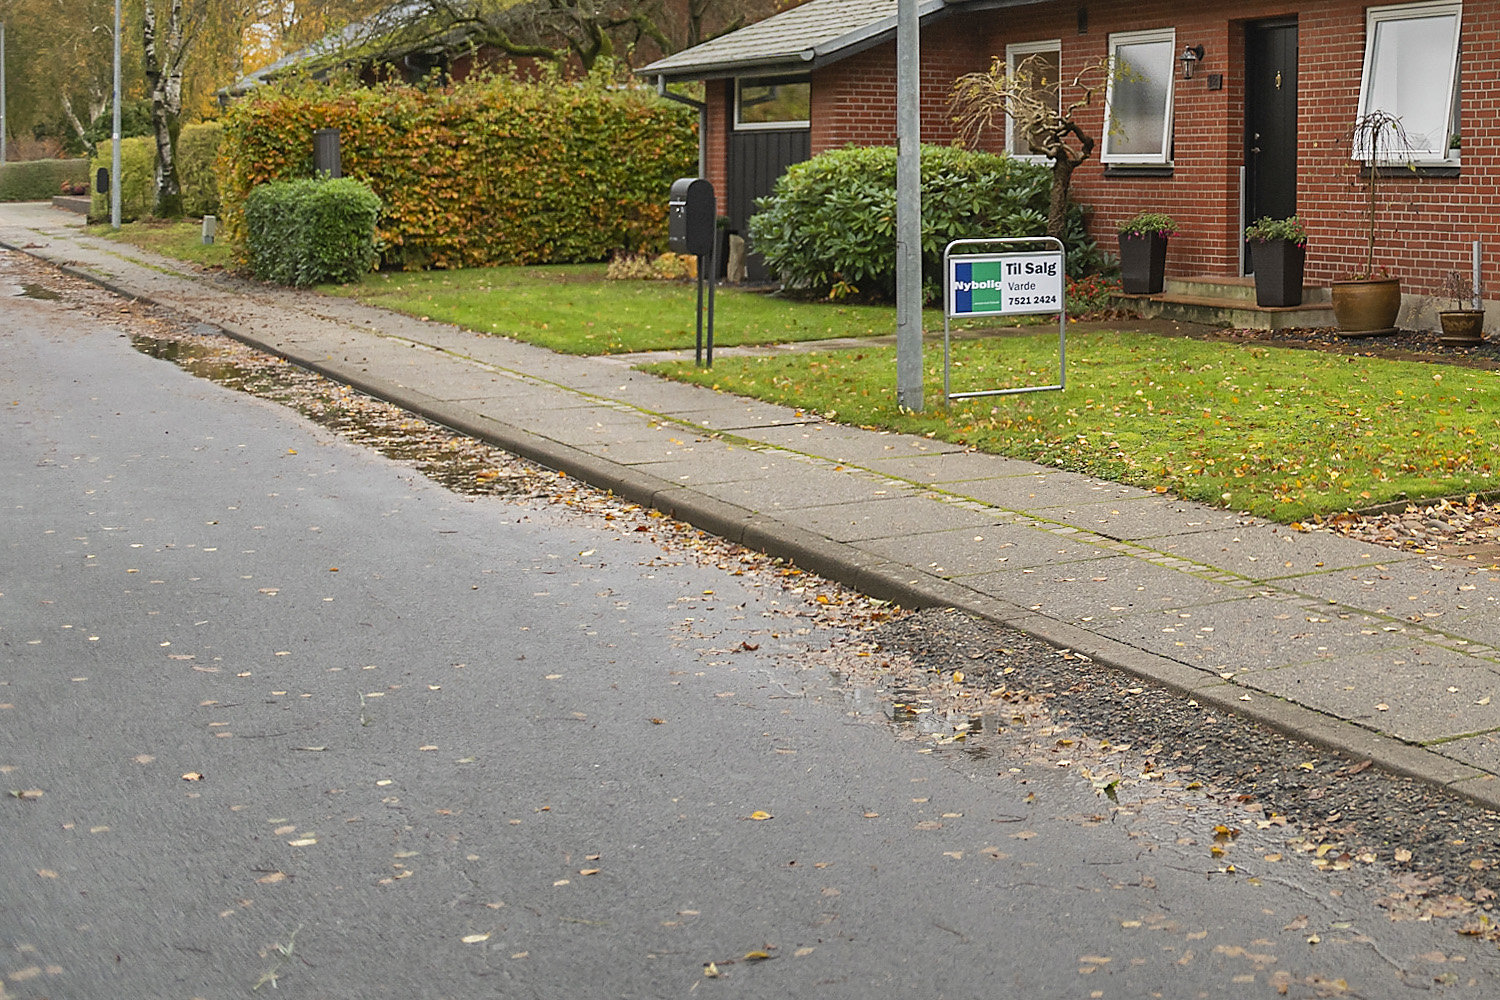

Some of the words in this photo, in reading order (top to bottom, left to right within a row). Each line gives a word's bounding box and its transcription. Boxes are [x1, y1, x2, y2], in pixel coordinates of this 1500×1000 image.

[1006, 263, 1021, 275] Til
[1025, 262, 1057, 276] Salg
[955, 280, 1001, 291] Nybolig
[1008, 282, 1036, 291] Varde
[1009, 297, 1031, 305] 7521
